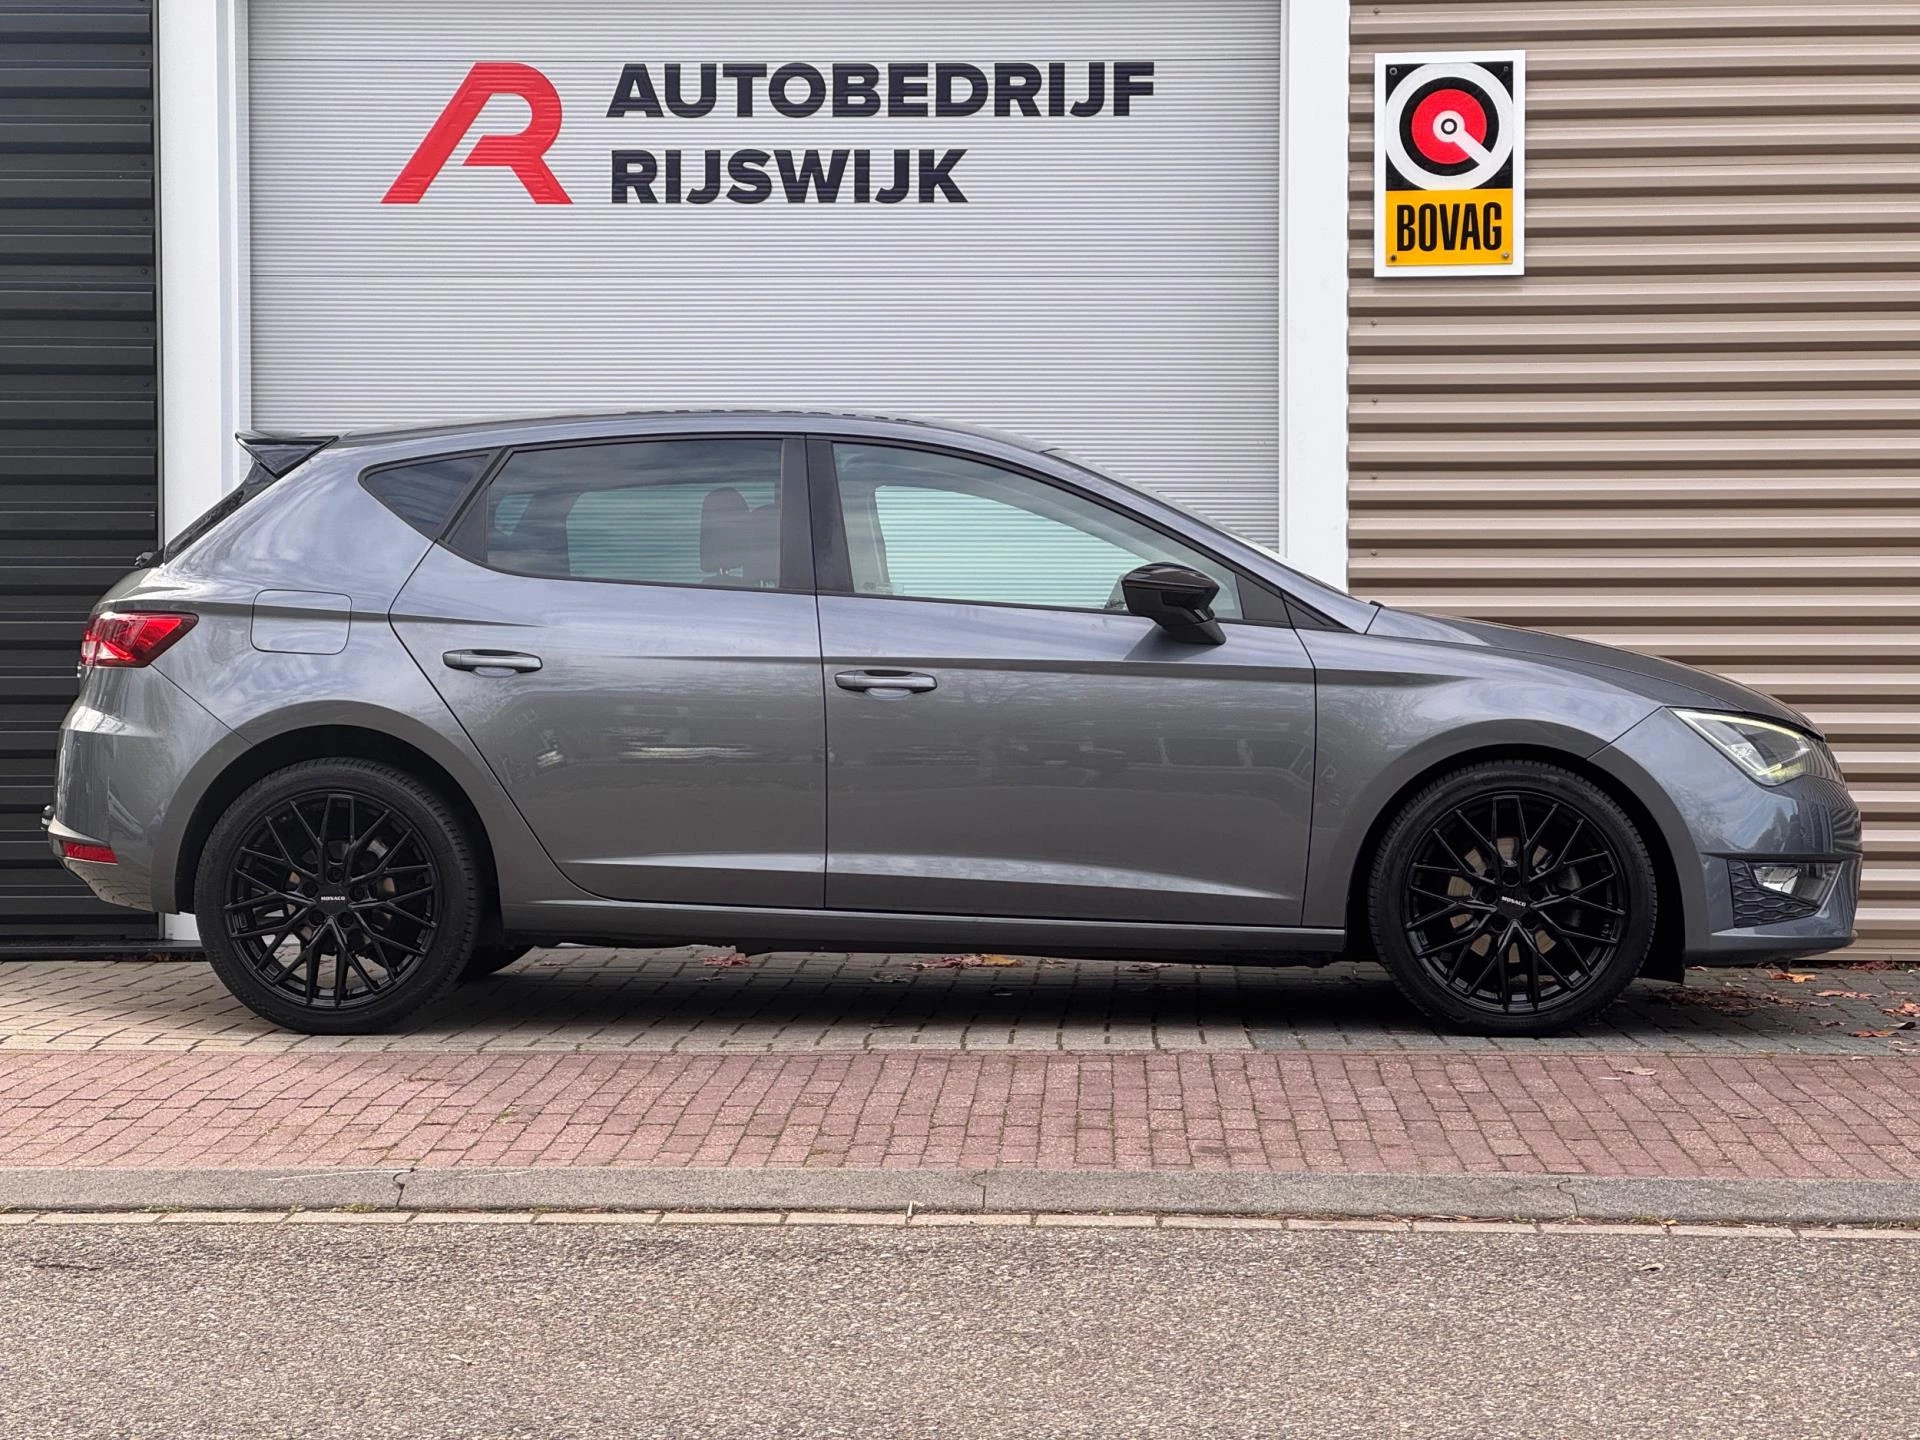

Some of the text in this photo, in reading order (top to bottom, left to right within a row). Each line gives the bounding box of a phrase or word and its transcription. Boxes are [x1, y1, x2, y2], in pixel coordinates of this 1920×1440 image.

[607, 61, 1156, 119] AUTOBEDRIJF
[611, 149, 969, 205] RIJSWIJK
[1396, 202, 1503, 252] BOVAG
